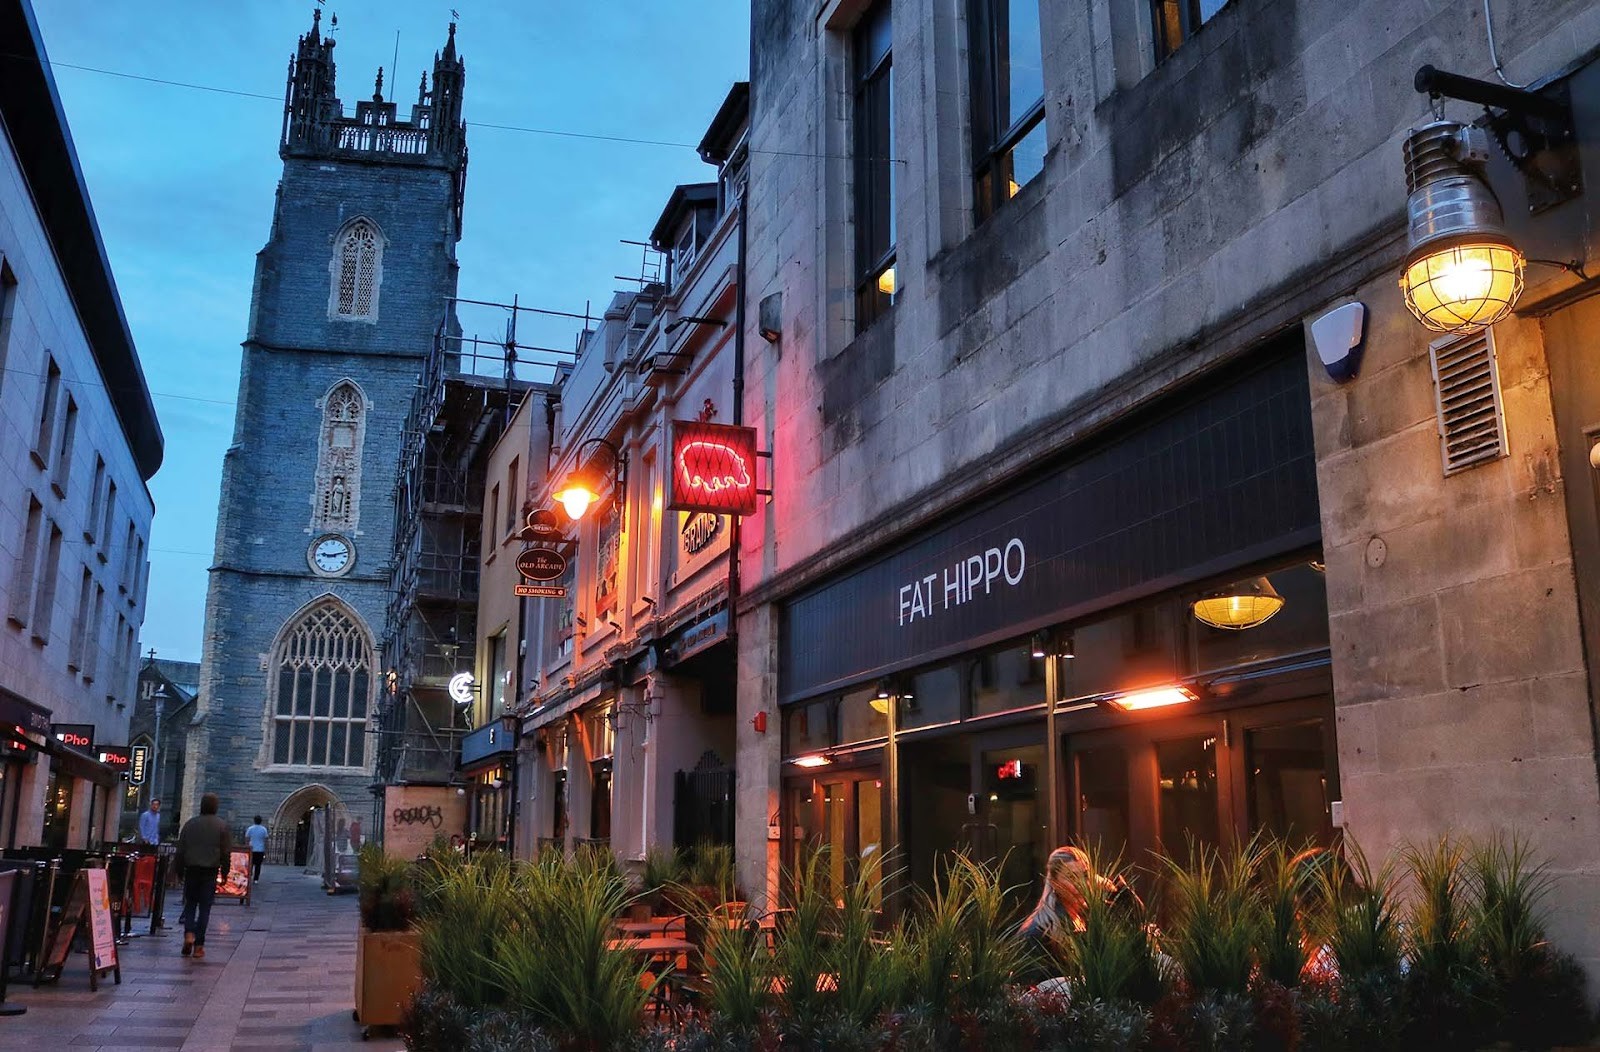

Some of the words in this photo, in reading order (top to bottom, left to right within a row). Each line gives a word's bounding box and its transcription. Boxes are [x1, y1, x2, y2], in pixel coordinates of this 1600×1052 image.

[535, 563, 563, 571] ARCADE
[899, 573, 938, 627] FAT
[943, 537, 1026, 610] HIPPO
[64, 733, 89, 746] Pho
[105, 754, 127, 764] Pho
[134, 749, 144, 781] HONEST
